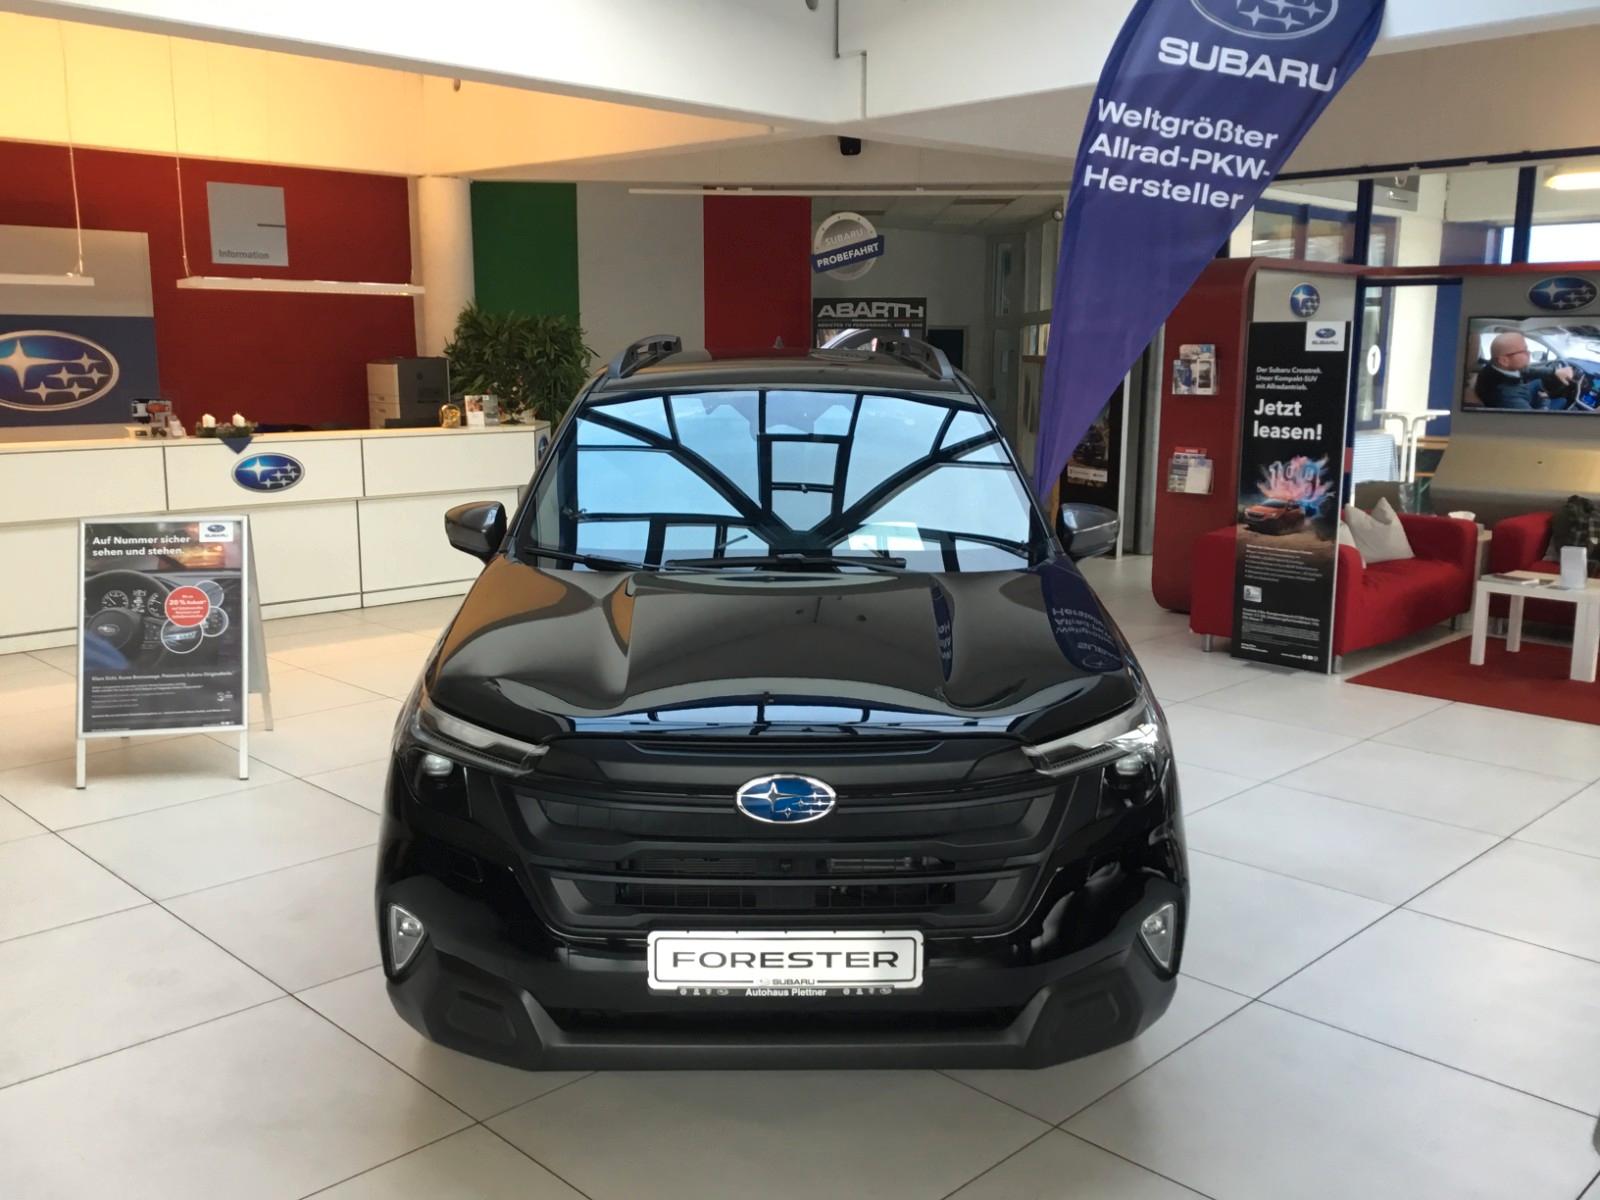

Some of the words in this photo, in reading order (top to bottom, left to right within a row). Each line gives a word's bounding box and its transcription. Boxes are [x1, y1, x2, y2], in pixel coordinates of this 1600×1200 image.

[1158, 37, 1337, 92] SUBARU
[1098, 99, 1279, 149] Weltgrößter
[1088, 133, 1271, 180] Allrad-PKW-
[1083, 165, 1244, 210] Hersteller
[825, 228, 864, 245] SUBARU
[218, 249, 270, 259] Information
[816, 242, 879, 268] PROBEFAHRT
[817, 301, 924, 318] ABARTH
[1254, 399, 1302, 417] Jetzt
[1253, 420, 1323, 441] leasen!
[92, 536, 112, 545] Auf
[113, 536, 158, 545] Nummer
[160, 535, 191, 544] sicher
[92, 547, 123, 557] sehen
[125, 547, 146, 556] und
[148, 546, 185, 556] stehen.
[672, 951, 899, 969] FORESTER
[745, 987, 789, 997] Autohaus
[791, 987, 827, 997] Plettner
